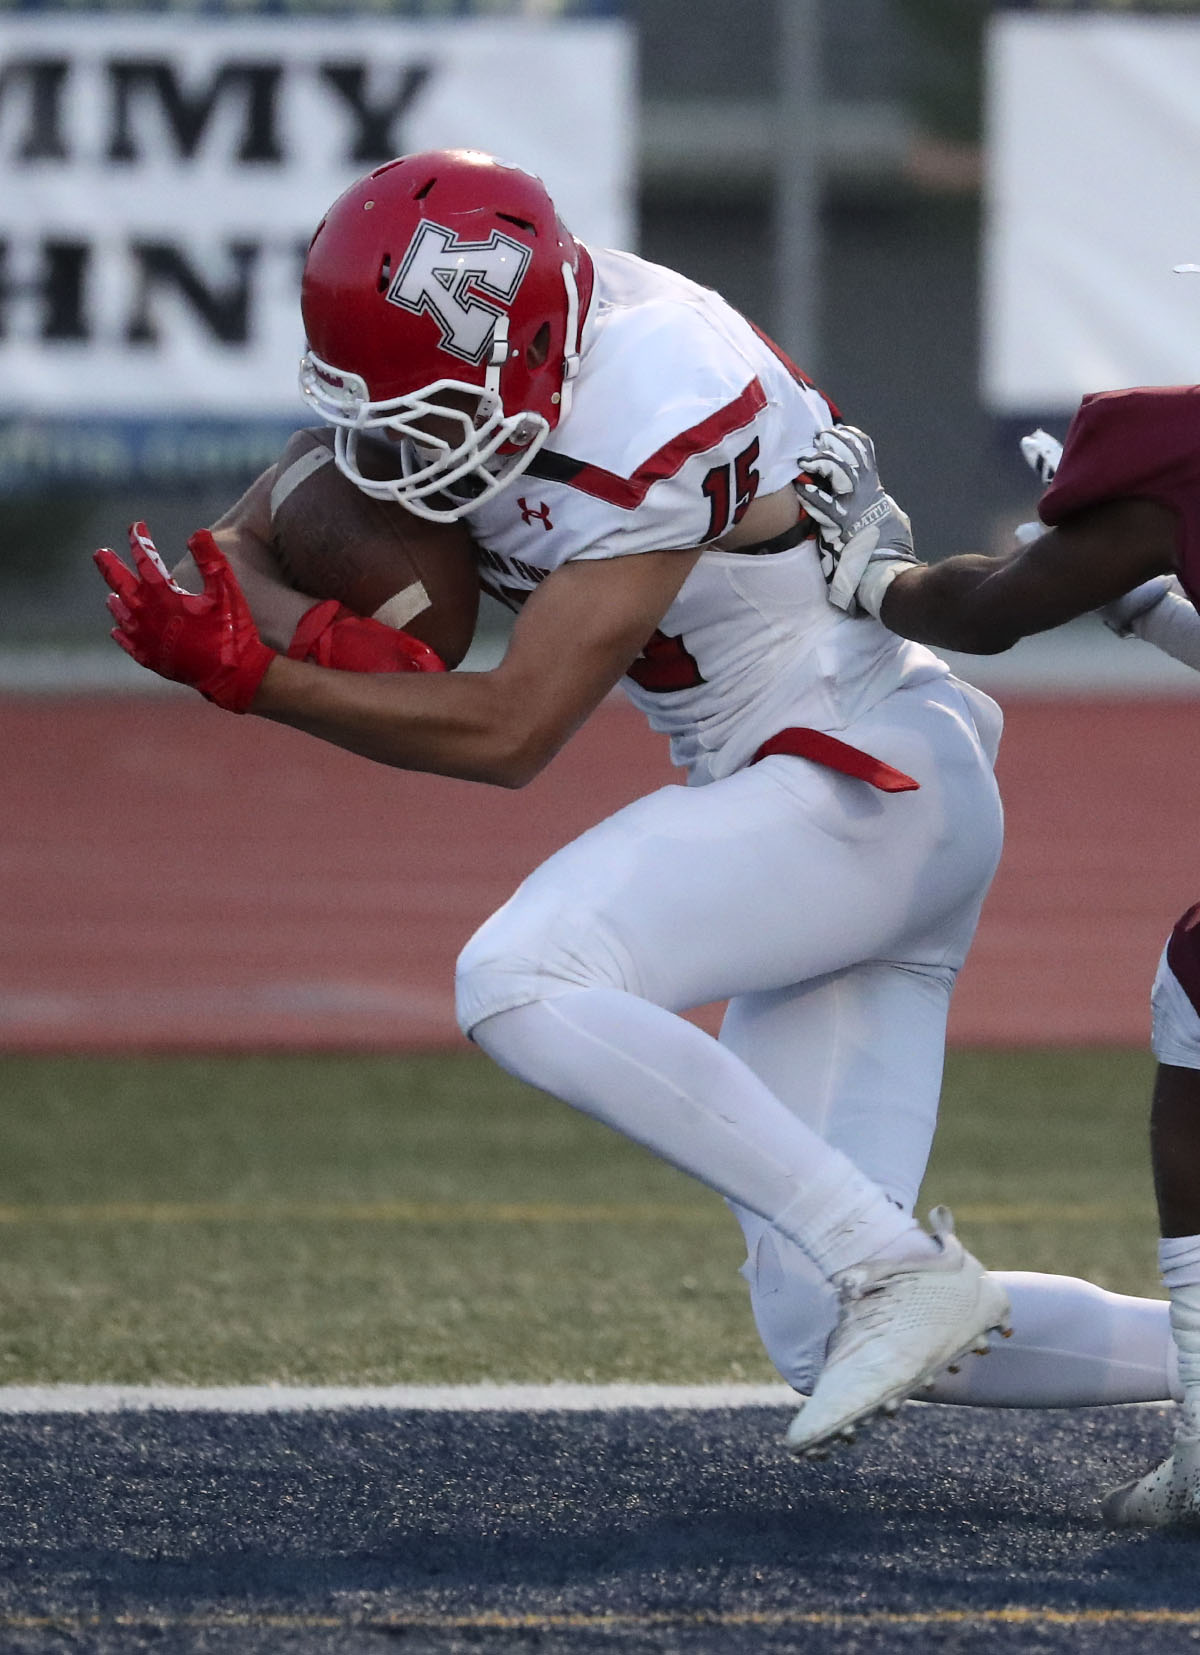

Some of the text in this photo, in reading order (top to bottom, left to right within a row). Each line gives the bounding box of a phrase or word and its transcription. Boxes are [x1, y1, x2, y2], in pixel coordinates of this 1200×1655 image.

[386, 218, 532, 366] A
[697, 435, 761, 545] 15
[853, 499, 891, 532] BATTLE
